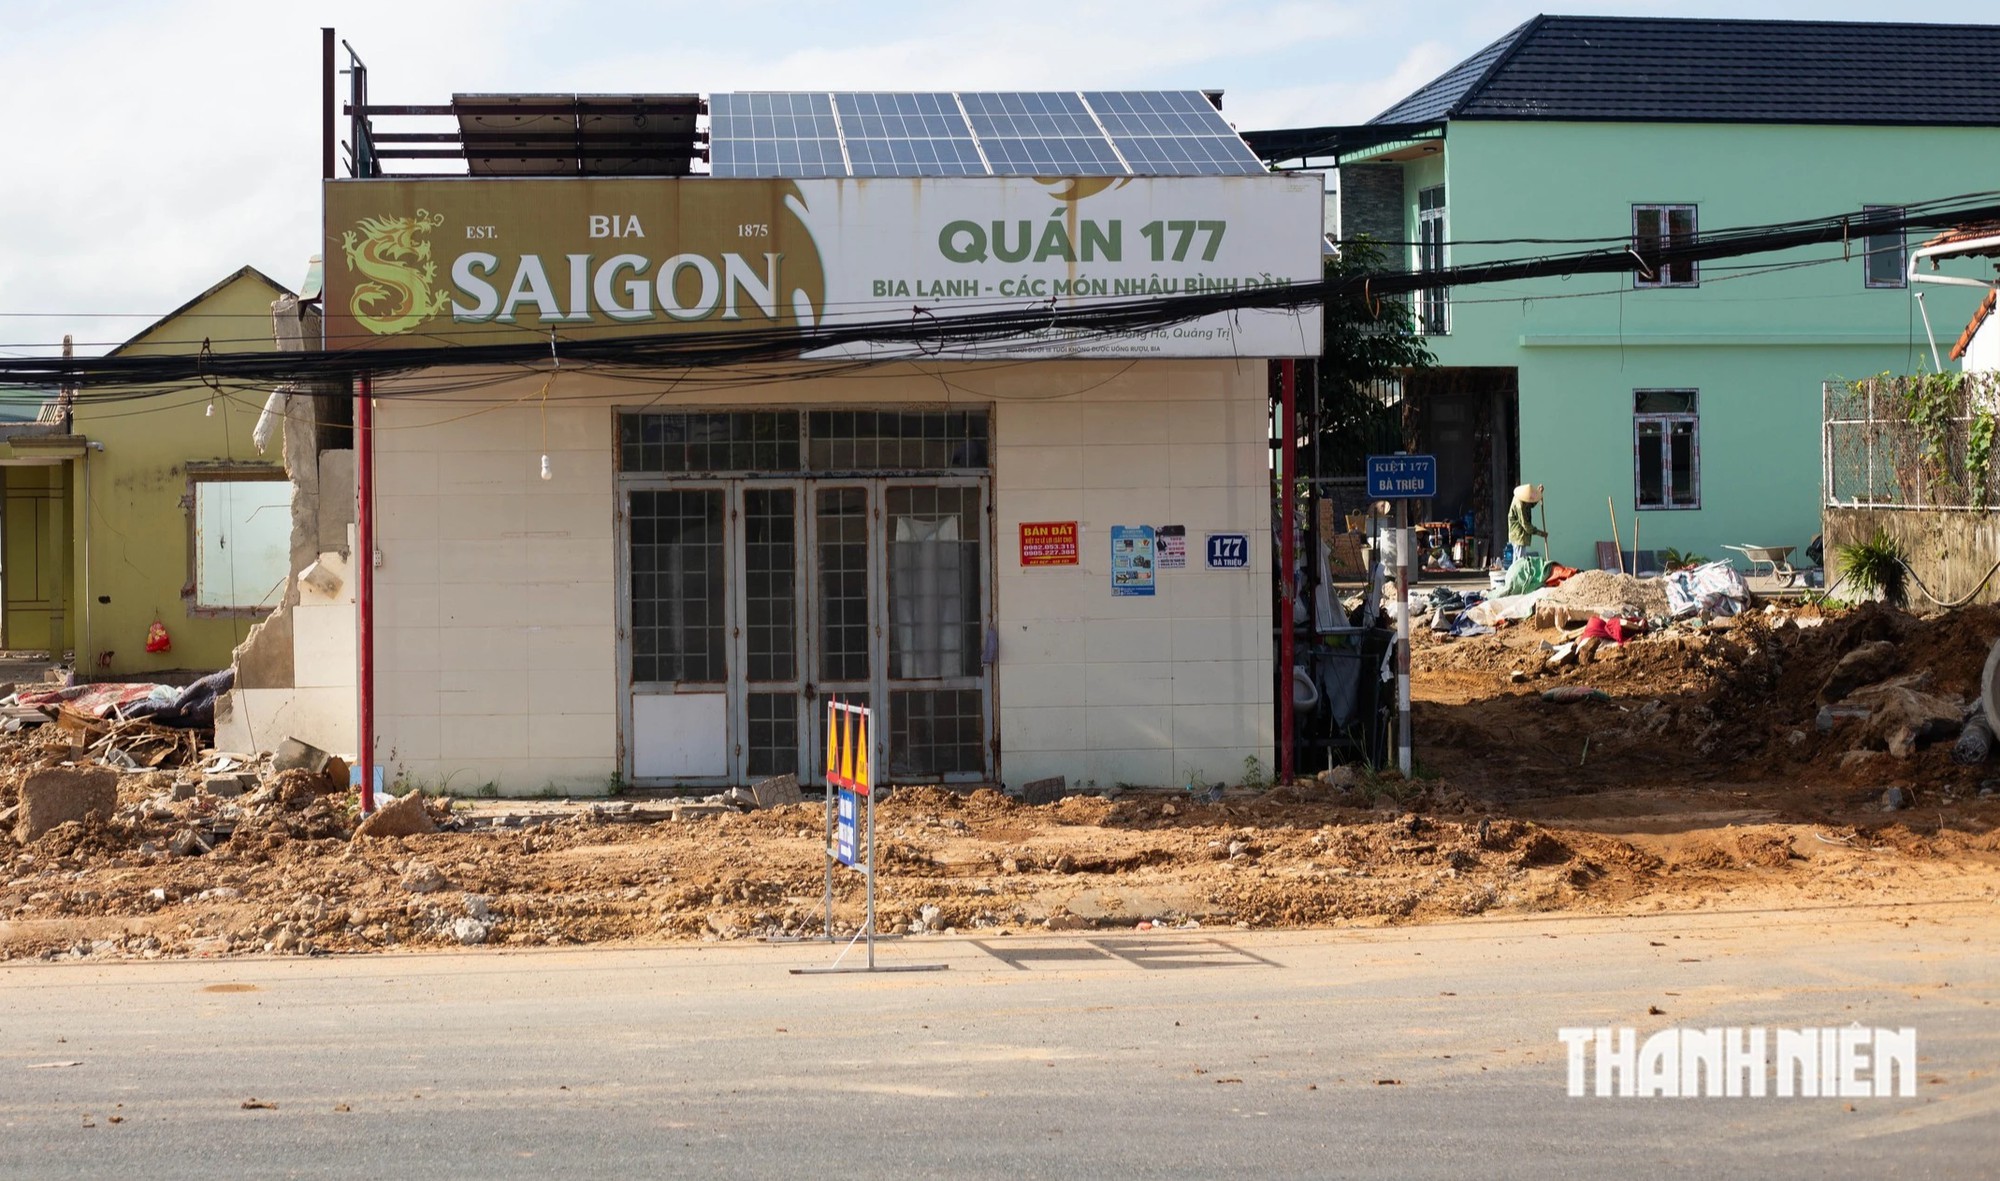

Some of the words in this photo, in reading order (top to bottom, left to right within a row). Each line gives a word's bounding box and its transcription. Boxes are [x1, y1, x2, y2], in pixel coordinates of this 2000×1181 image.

[466, 226, 498, 239] EST.
[589, 215, 645, 239] BIA
[737, 224, 768, 238] 1875
[938, 207, 1122, 264] QUÁN
[1139, 220, 1227, 263] 177
[450, 251, 784, 324] SAIGON
[873, 280, 910, 297] BIA
[917, 280, 979, 303] LẠNH
[999, 274, 1047, 297] CÁC
[1053, 274, 1107, 297] MÓN
[1184, 272, 1238, 296] BÌNH
[1173, 327, 1213, 341] Quảng
[1216, 327, 1231, 341] Trị
[1375, 460, 1406, 475] KIỆT
[1410, 462, 1429, 471] 177
[1379, 477, 1393, 491] BÀ
[1396, 475, 1424, 493] TRIỆU
[1024, 525, 1048, 536] BÁN
[1051, 523, 1073, 536] ĐẤT
[1213, 538, 1242, 557] 177
[1213, 557, 1222, 566] BÀ
[1223, 557, 1242, 567] TRIỆU
